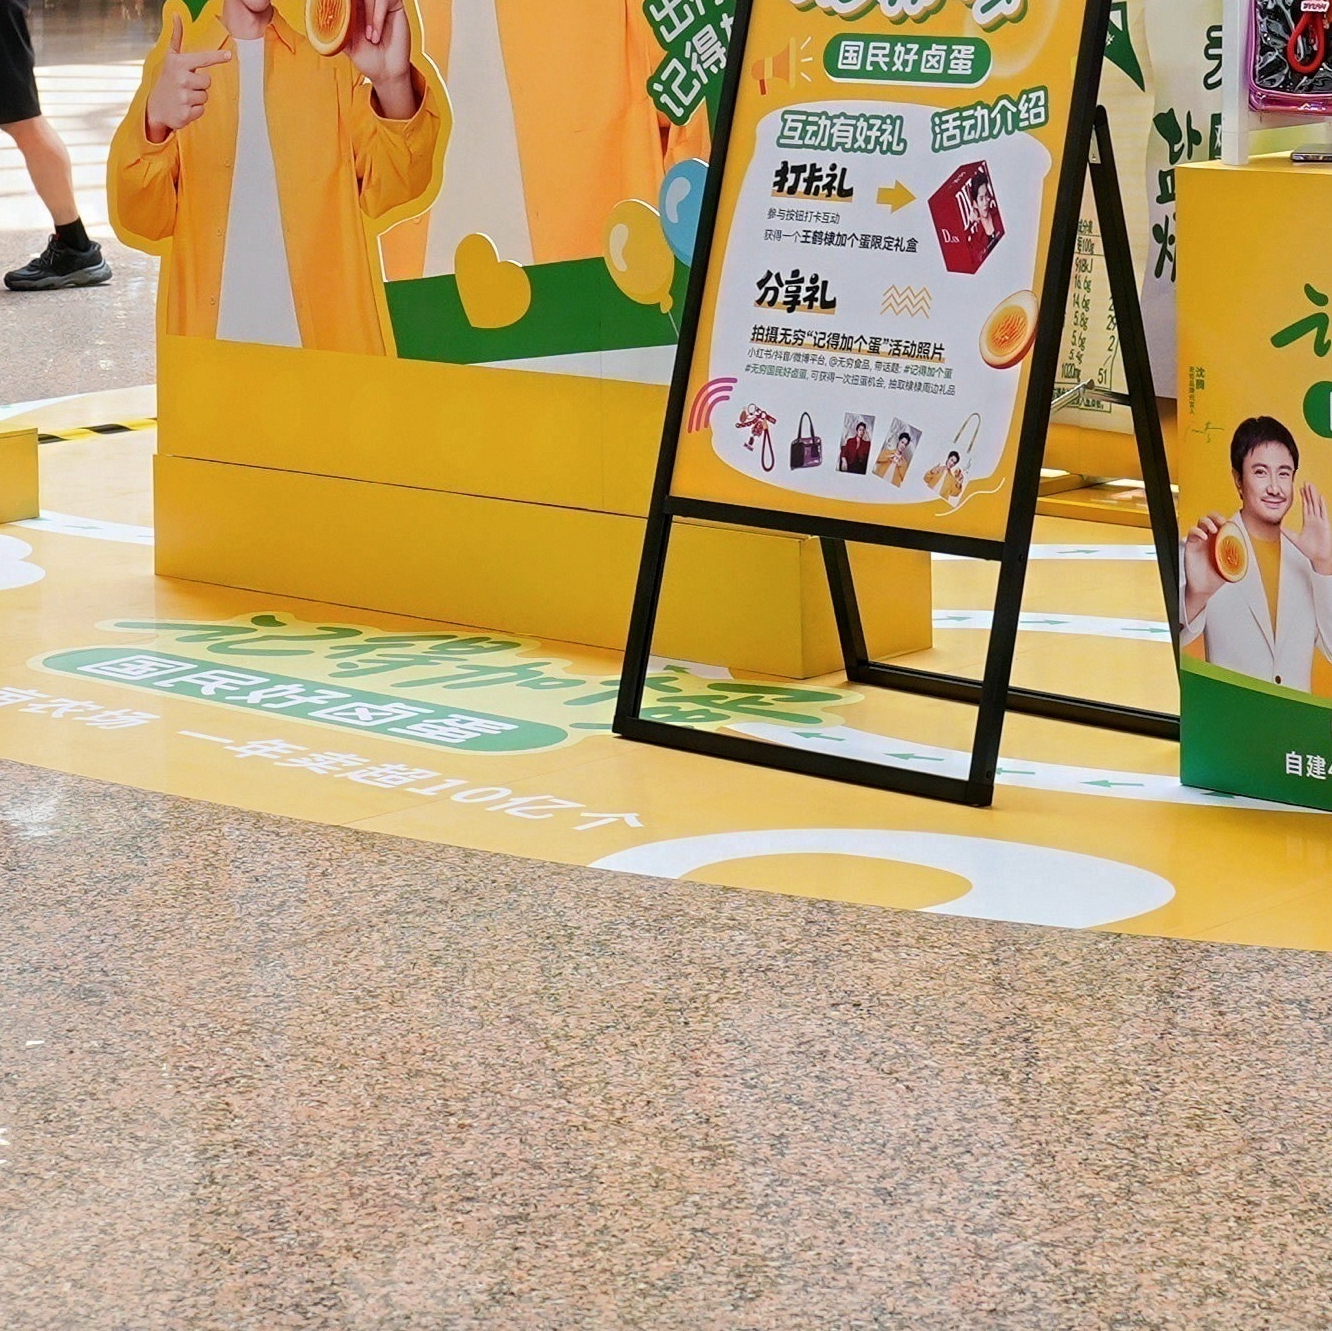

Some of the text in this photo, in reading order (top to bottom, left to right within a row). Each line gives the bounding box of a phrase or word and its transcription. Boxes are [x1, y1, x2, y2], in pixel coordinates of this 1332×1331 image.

[838, 41, 975, 77] 国民好卤蛋
[779, 90, 1047, 153] 互动有好礼 活动介绍
[773, 160, 854, 199] 打卡礼
[754, 268, 837, 313] 分享礼
[78, 653, 520, 748] 国民好卤蛋
[177, 727, 646, 831] 一年卖超10亿个
